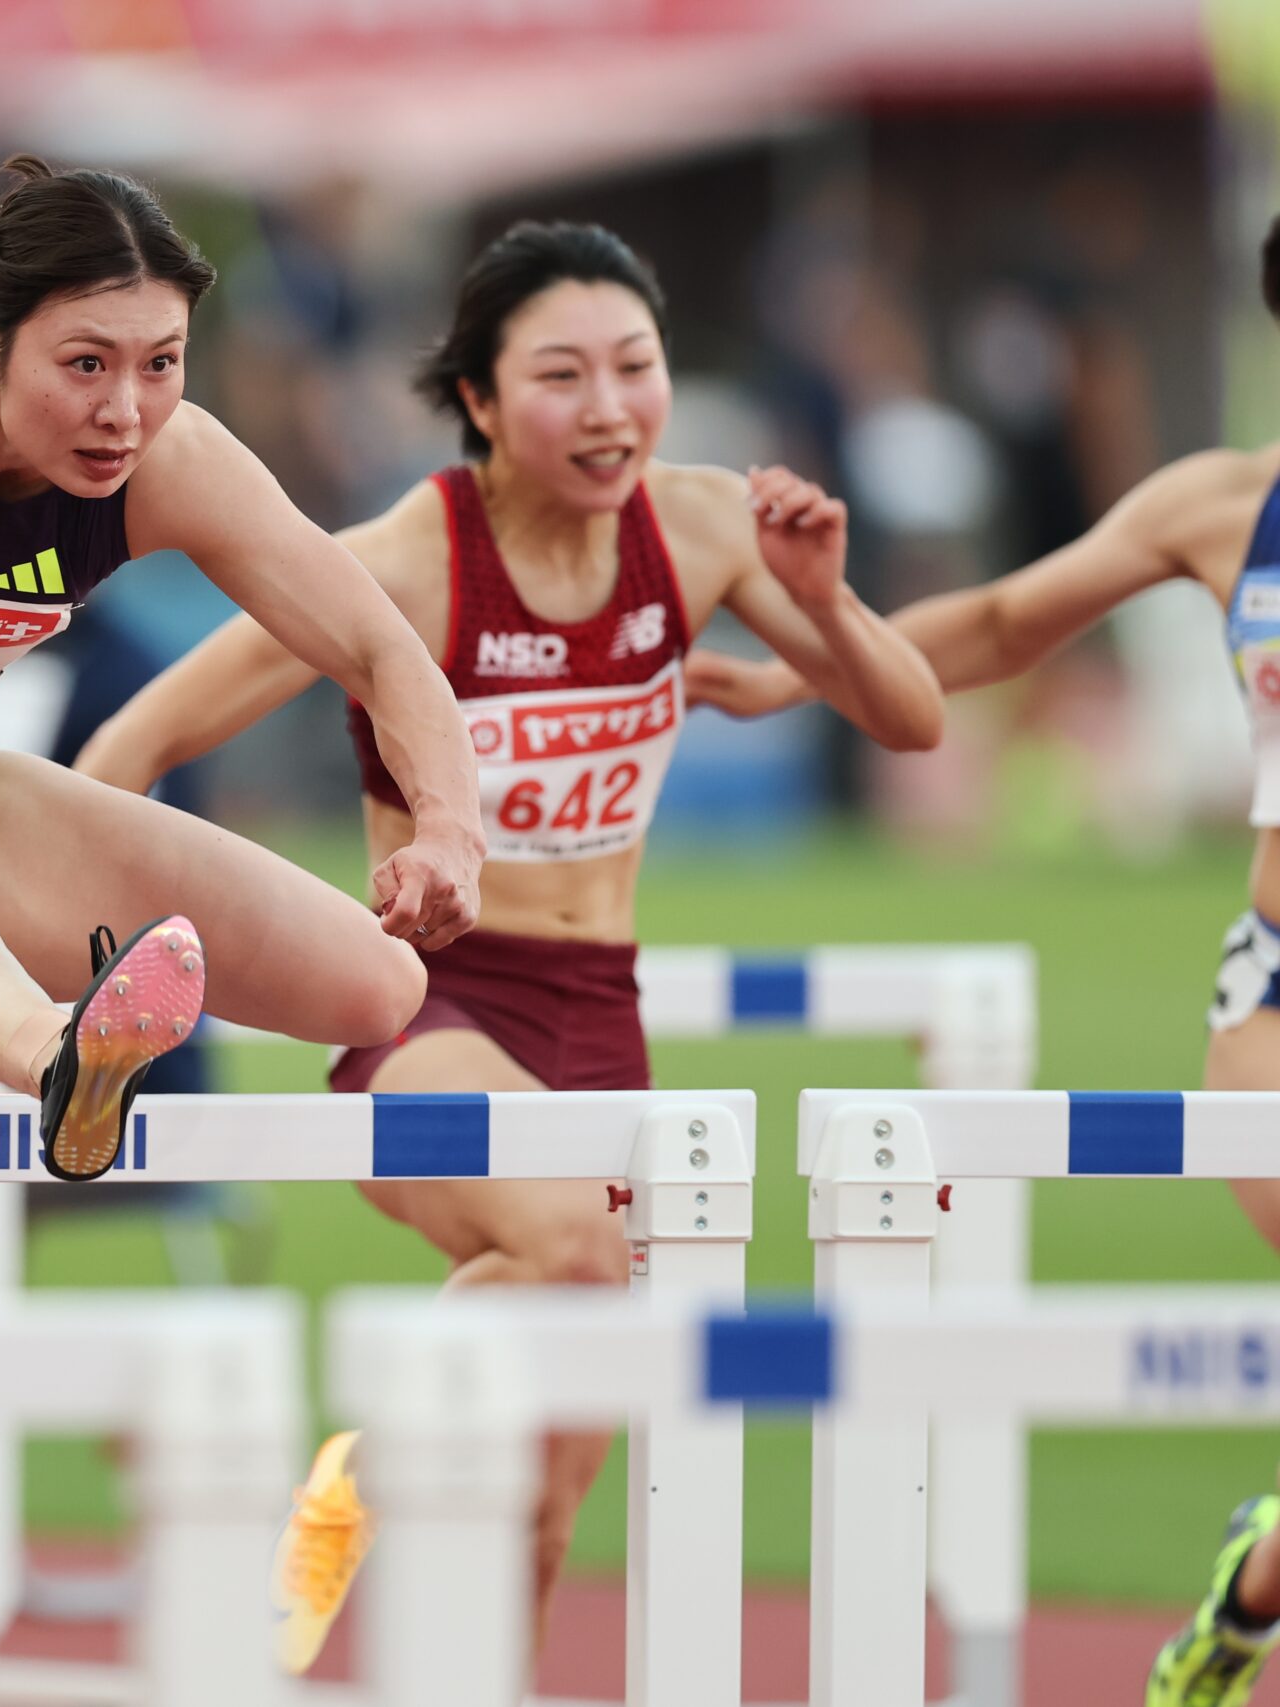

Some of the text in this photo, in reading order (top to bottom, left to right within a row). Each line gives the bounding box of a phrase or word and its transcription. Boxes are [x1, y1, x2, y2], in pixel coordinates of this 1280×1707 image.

[522, 693, 672, 752] ヤマザキ
[498, 762, 641, 834] 642
